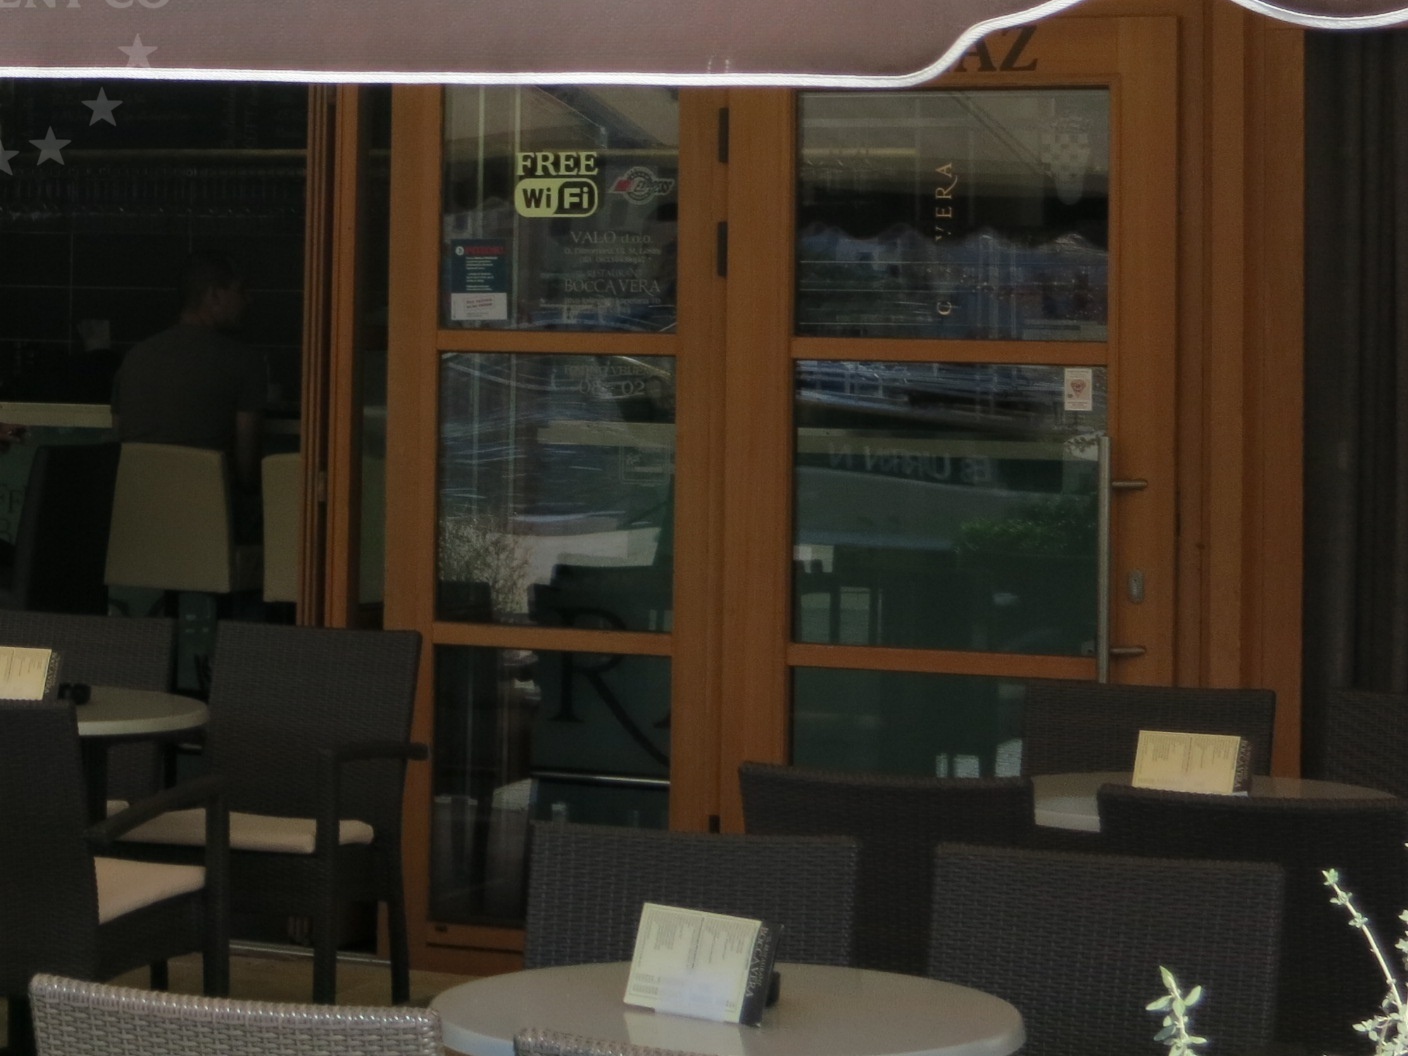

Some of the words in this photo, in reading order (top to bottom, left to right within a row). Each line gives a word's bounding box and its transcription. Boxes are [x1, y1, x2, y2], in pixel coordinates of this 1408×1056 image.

[516, 151, 600, 176] FREE
[569, 230, 617, 244] VALO
[564, 278, 617, 295] BOCCA
[618, 279, 661, 296] VERA
